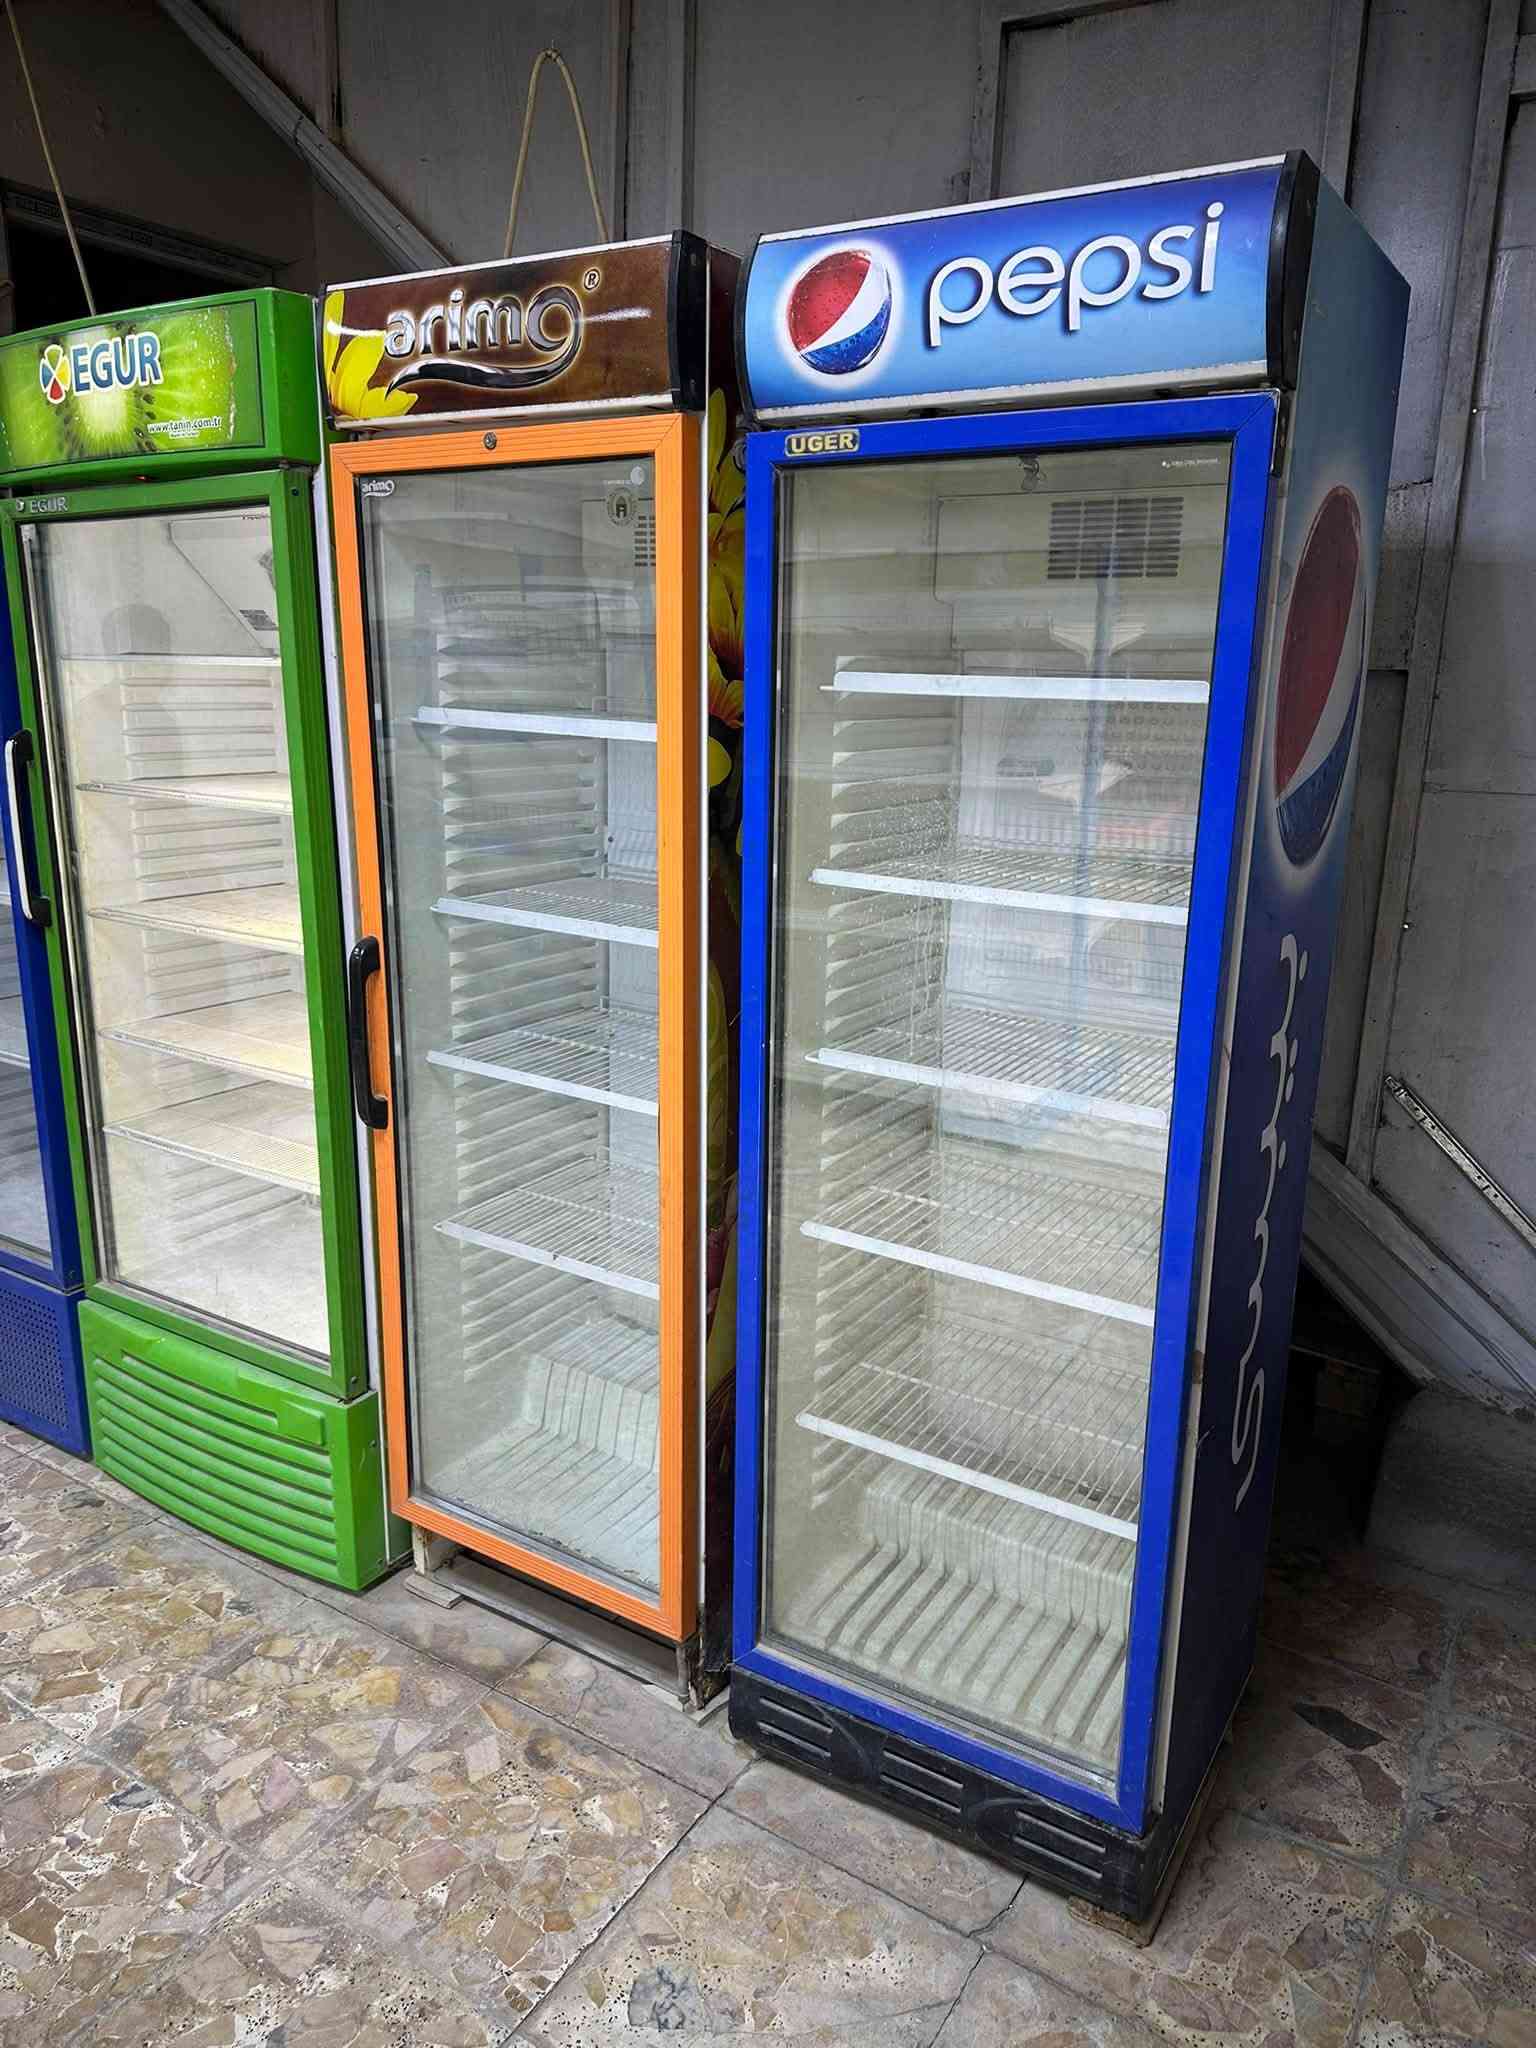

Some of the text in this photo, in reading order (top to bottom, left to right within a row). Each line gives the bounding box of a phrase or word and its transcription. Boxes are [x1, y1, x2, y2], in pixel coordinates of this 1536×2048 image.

[928, 202, 1225, 347] pepsi
[71, 332, 163, 394] EGUR
[790, 431, 856, 455] UGER
[31, 497, 69, 513] EGUR
